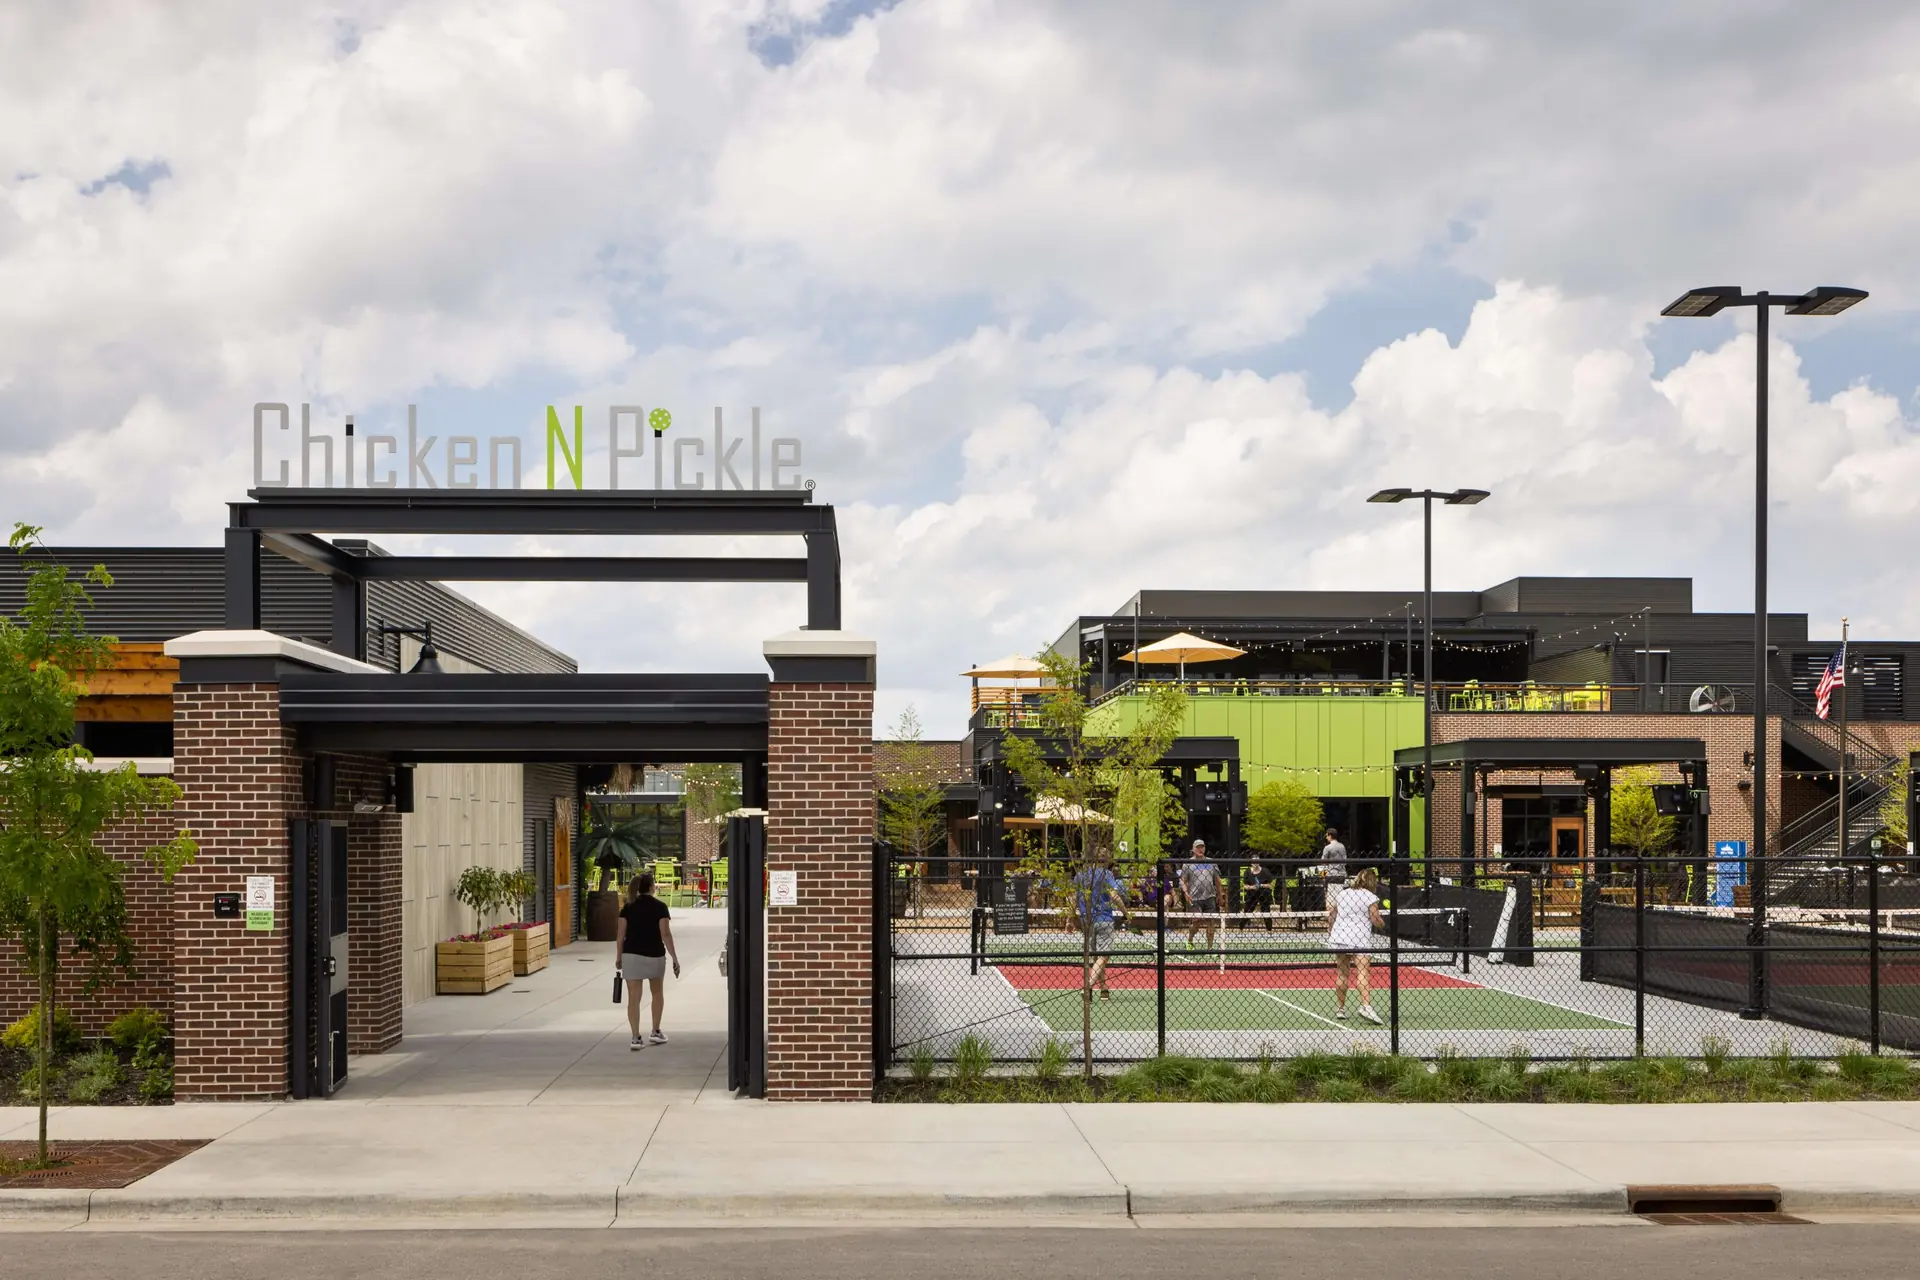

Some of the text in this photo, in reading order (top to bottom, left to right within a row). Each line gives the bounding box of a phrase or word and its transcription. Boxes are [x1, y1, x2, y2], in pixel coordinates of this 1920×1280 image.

[254, 402, 522, 489] Chicken
[546, 405, 583, 490] N
[1447, 913, 1455, 927] 4
